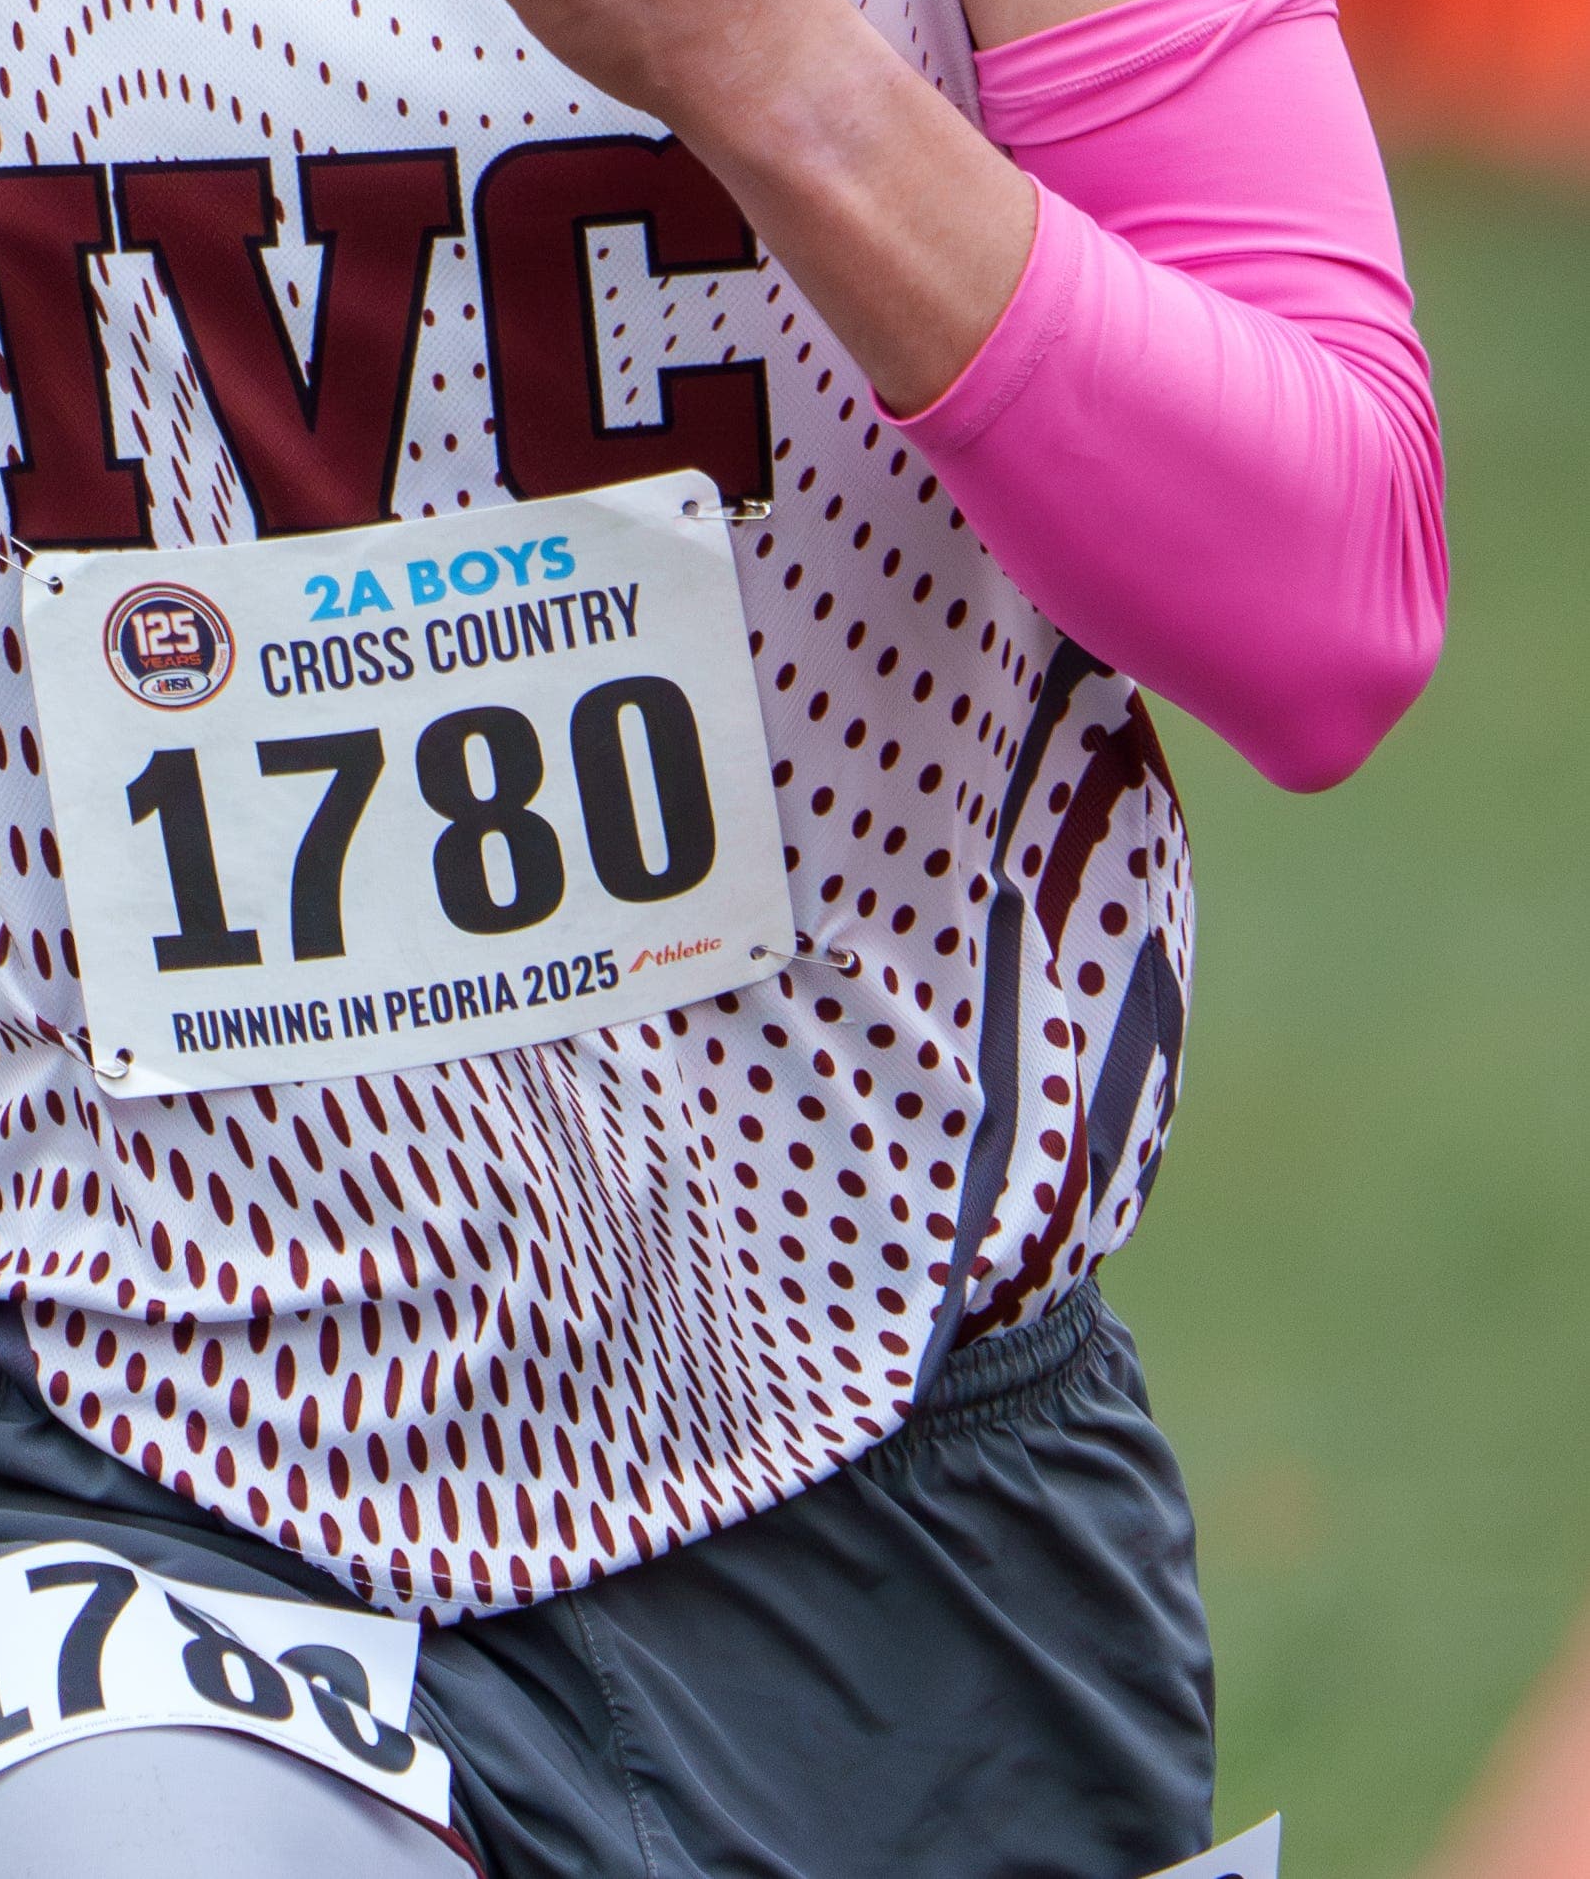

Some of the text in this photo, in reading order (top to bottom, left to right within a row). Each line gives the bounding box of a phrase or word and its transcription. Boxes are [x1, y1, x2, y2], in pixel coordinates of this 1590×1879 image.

[304, 536, 576, 622] 2A BOYS
[131, 611, 200, 656] 125
[140, 653, 202, 669] YEARS
[260, 582, 640, 698] CROSS COUNTRY
[125, 676, 716, 973] 1780
[172, 949, 620, 1053] RUNNING IN PEORIA 2025
